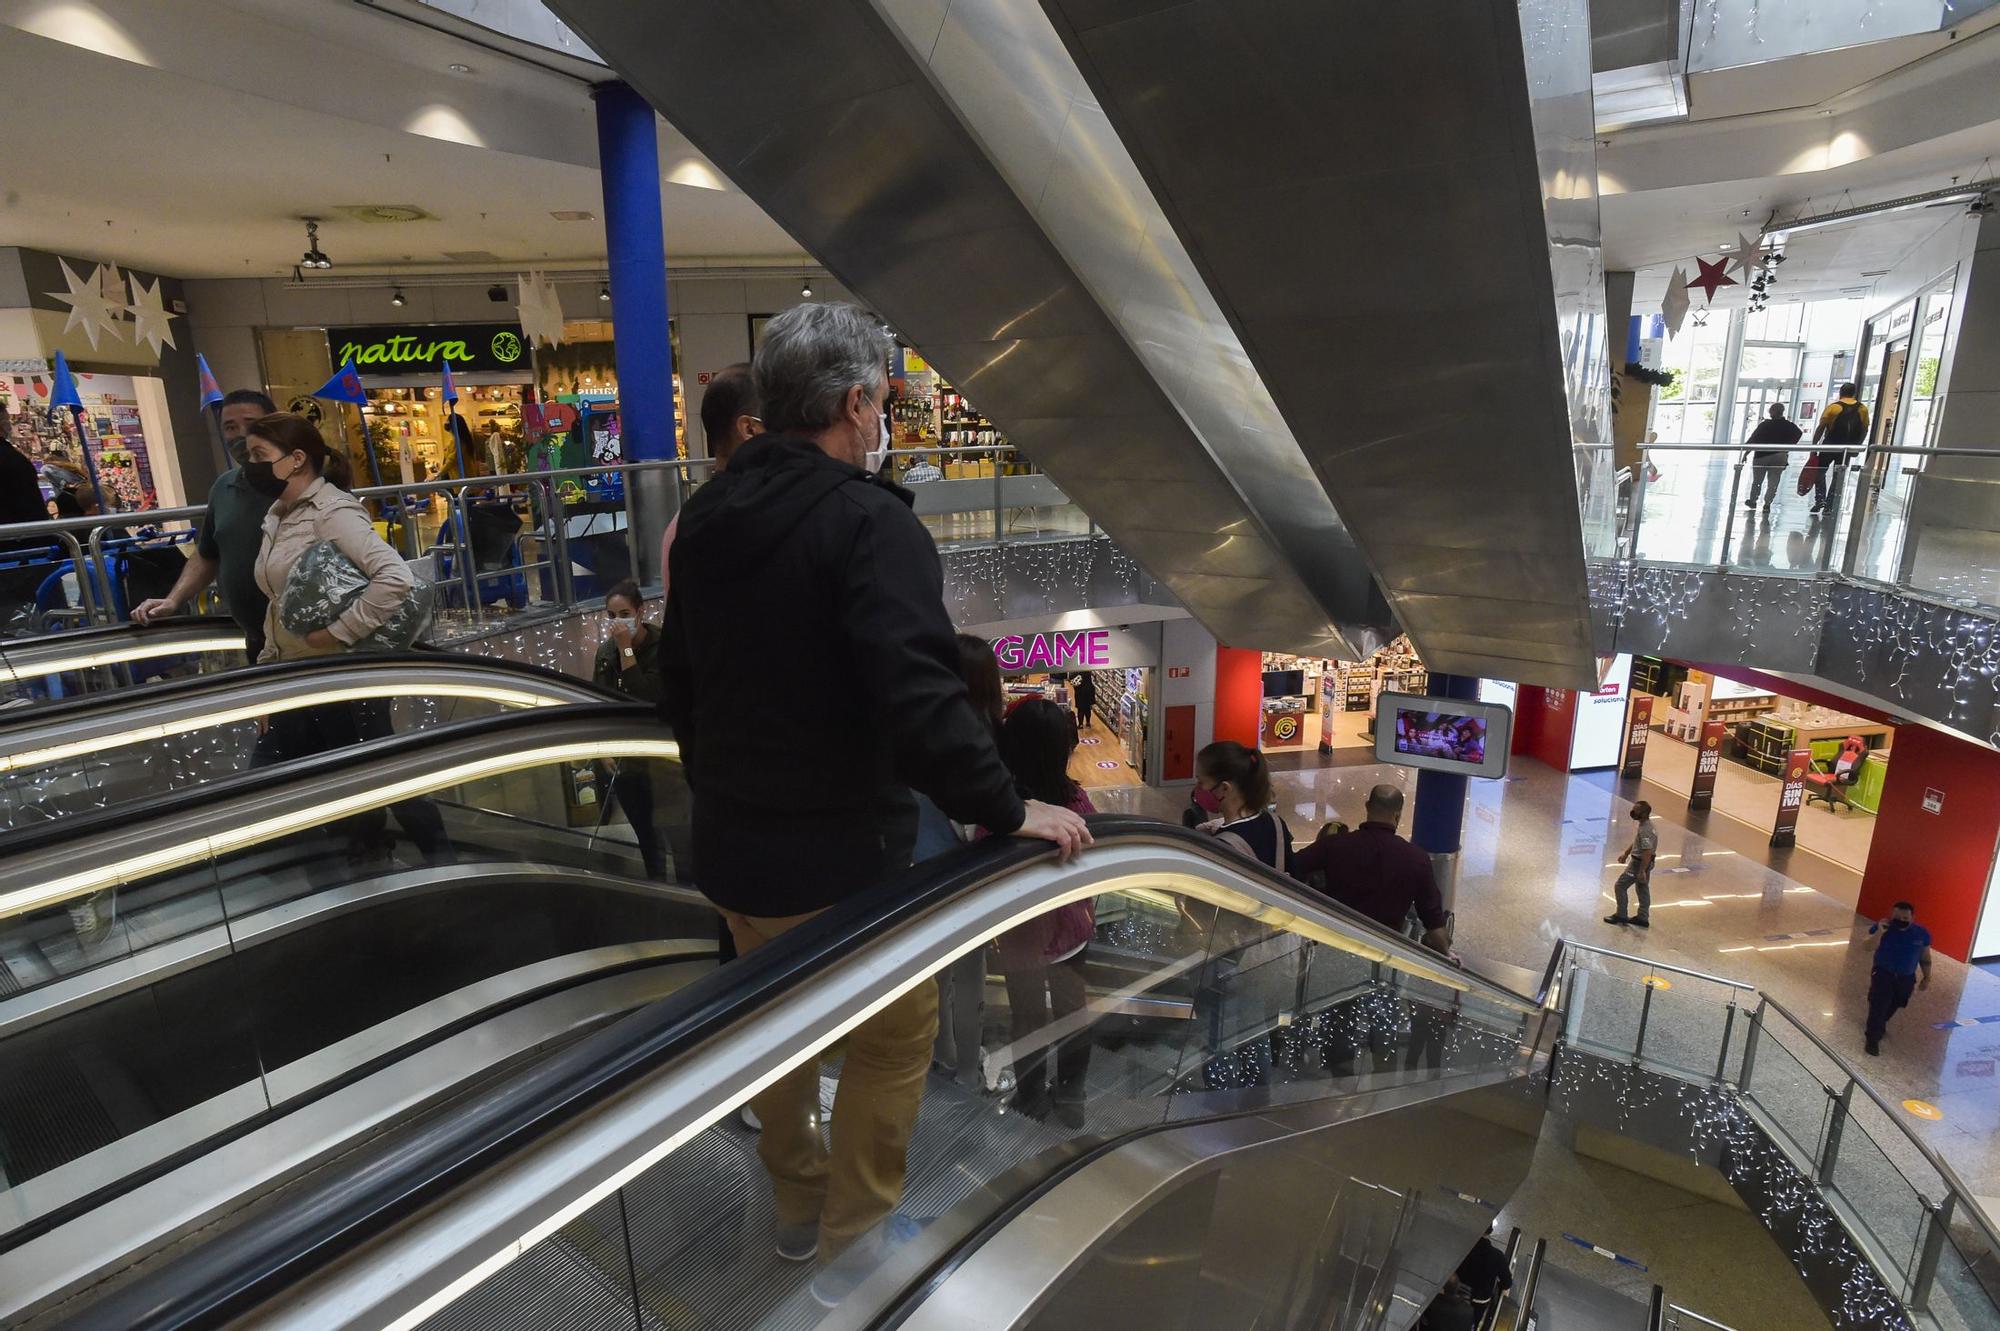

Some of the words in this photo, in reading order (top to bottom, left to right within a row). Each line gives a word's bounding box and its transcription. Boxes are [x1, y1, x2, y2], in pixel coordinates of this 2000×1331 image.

[339, 335, 475, 366] natura
[992, 631, 1110, 669] GAME
[1631, 729, 1648, 738] SIN
[1631, 737, 1646, 745] IVA
[1700, 757, 1718, 766] SIN
[1699, 765, 1717, 773] IVA
[1784, 789, 1802, 798] SIN
[1783, 798, 1800, 807] IVA
